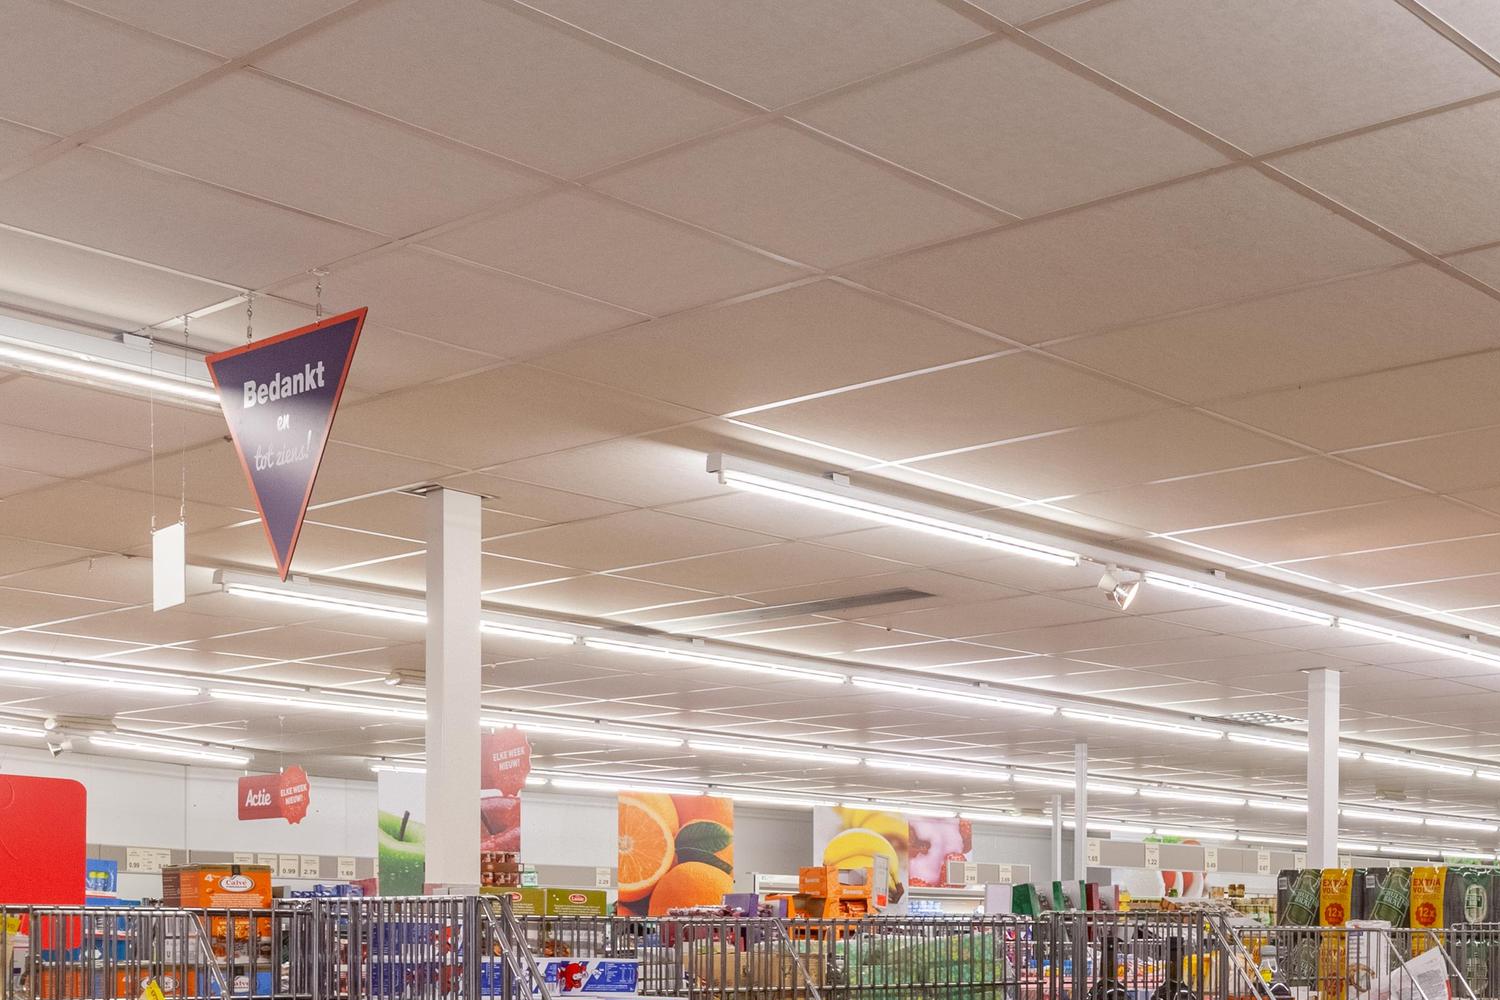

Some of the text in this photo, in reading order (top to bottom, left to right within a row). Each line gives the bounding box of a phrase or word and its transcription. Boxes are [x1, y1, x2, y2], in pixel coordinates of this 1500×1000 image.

[243, 361, 325, 409] Bedankt
[277, 414, 290, 431] en
[254, 430, 312, 471] tot ziens!
[493, 747, 525, 762] ELKE WEEK
[499, 758, 521, 771] NIEUW!
[244, 787, 272, 808] Actie
[280, 784, 307, 797] ELKE WEEK
